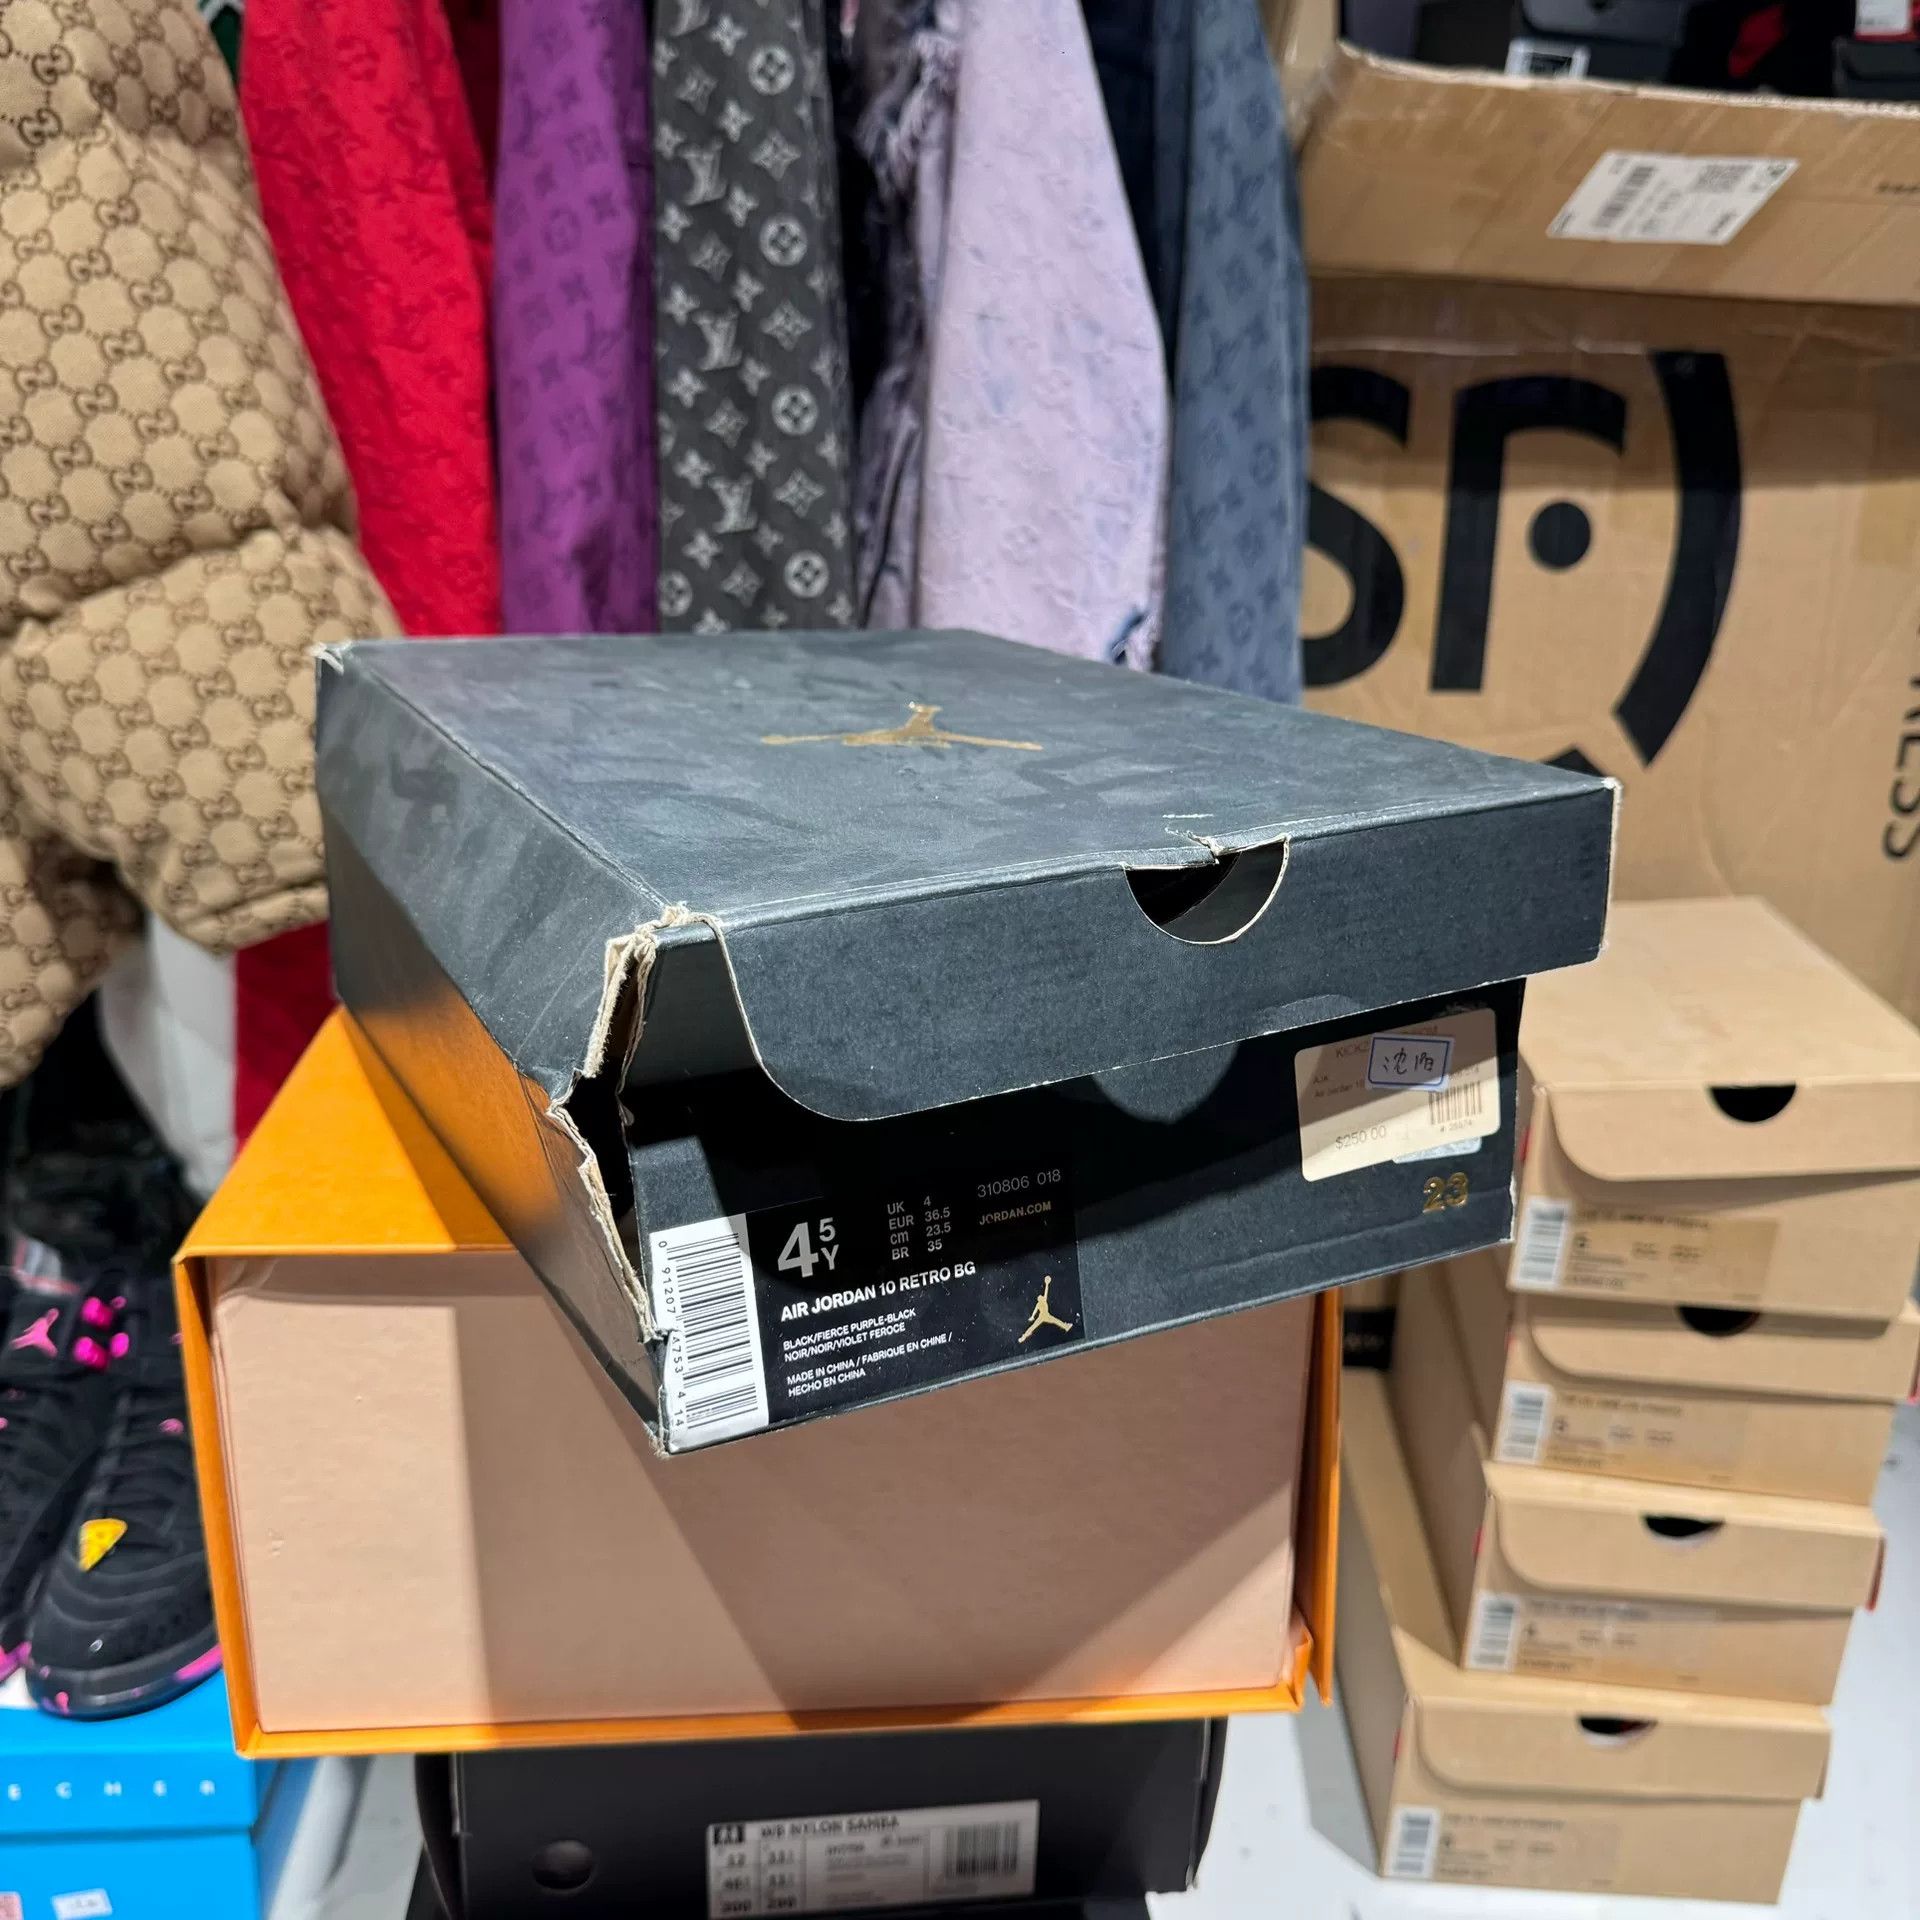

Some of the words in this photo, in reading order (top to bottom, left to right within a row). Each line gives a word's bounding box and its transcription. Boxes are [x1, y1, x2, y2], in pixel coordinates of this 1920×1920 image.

[977, 1175, 1030, 1198] 310806
[1036, 1169, 1061, 1185] 018
[1423, 1171, 1468, 1215] 23
[887, 1201, 905, 1215] UK
[923, 1196, 931, 1207] 4
[888, 1214, 915, 1230] EUR
[924, 1206, 951, 1222] 36.5
[979, 1201, 1052, 1226] JORDAN.COM
[777, 1221, 819, 1278] 4
[819, 1217, 836, 1242] 5
[890, 1230, 909, 1245] cm
[925, 1221, 951, 1237] 23.5
[820, 1243, 839, 1270] Y
[891, 1246, 910, 1261] BR
[927, 1238, 943, 1252] 35
[662, 1267, 676, 1314] 91207
[780, 1301, 809, 1322] AIR
[811, 1284, 876, 1314] JORDAN
[879, 1280, 896, 1296] 10
[900, 1266, 950, 1292] RETRO
[954, 1261, 976, 1278] BG
[783, 1324, 849, 1351] BLACK/FIERCE
[850, 1308, 917, 1333] PURPLE-BLACK
[784, 1332, 868, 1363] NOIR/NOIR/VIOLET
[869, 1322, 906, 1339] FEROCE
[786, 1371, 815, 1386] MADE
[815, 1366, 825, 1377] IN
[826, 1358, 856, 1375] CHINA
[861, 1344, 905, 1364] FABRIQUE
[906, 1341, 919, 1353] EN
[920, 1333, 947, 1349] CHINE
[788, 1379, 822, 1398] HECHO
[823, 1375, 837, 1388] EN
[837, 1367, 866, 1384] CHINA
